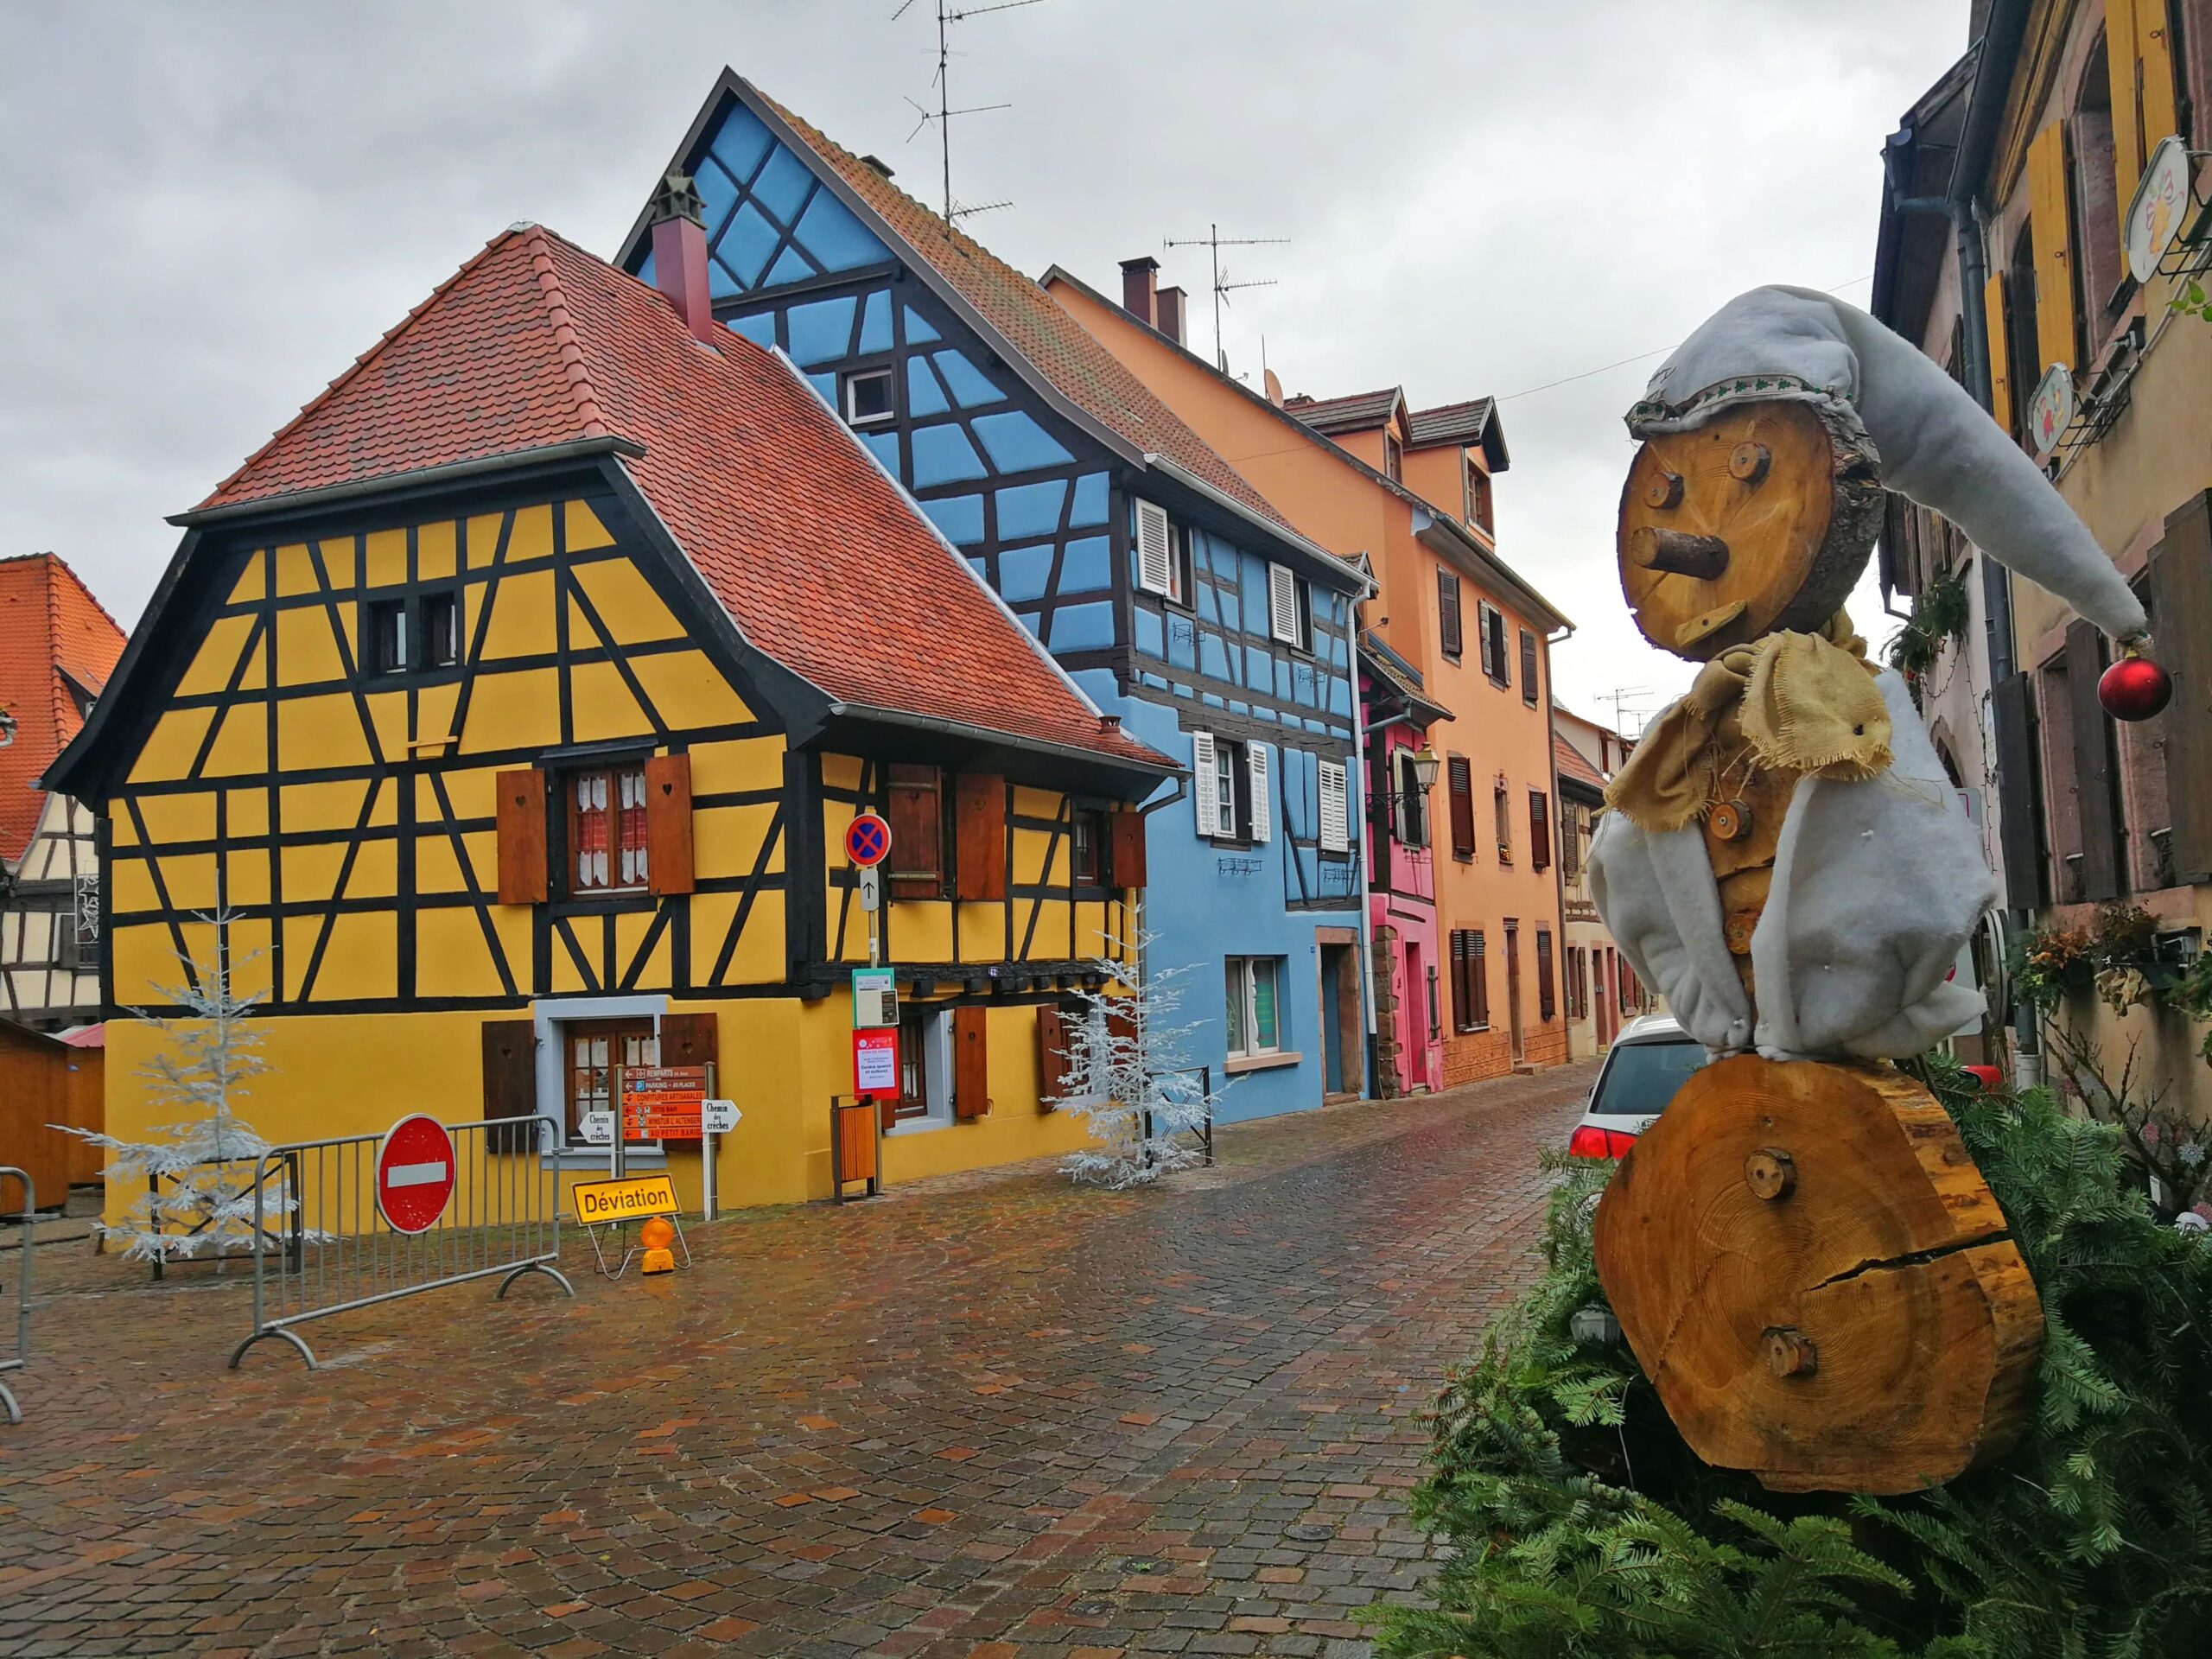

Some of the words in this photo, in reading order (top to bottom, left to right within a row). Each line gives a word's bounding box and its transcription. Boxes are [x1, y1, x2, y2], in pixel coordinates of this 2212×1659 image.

[646, 1069, 673, 1077] REMPARTS
[637, 1093, 668, 1102] CONFITURES
[669, 1092, 702, 1101] ARTISANALES
[706, 1103, 728, 1112] Chemin
[589, 1115, 609, 1124] Chemin
[676, 1116, 702, 1124] ALTENBER
[707, 1120, 729, 1129] crèches
[650, 1128, 659, 1137] AU
[661, 1128, 679, 1137] PETIT
[584, 1188, 669, 1213] Déviation
